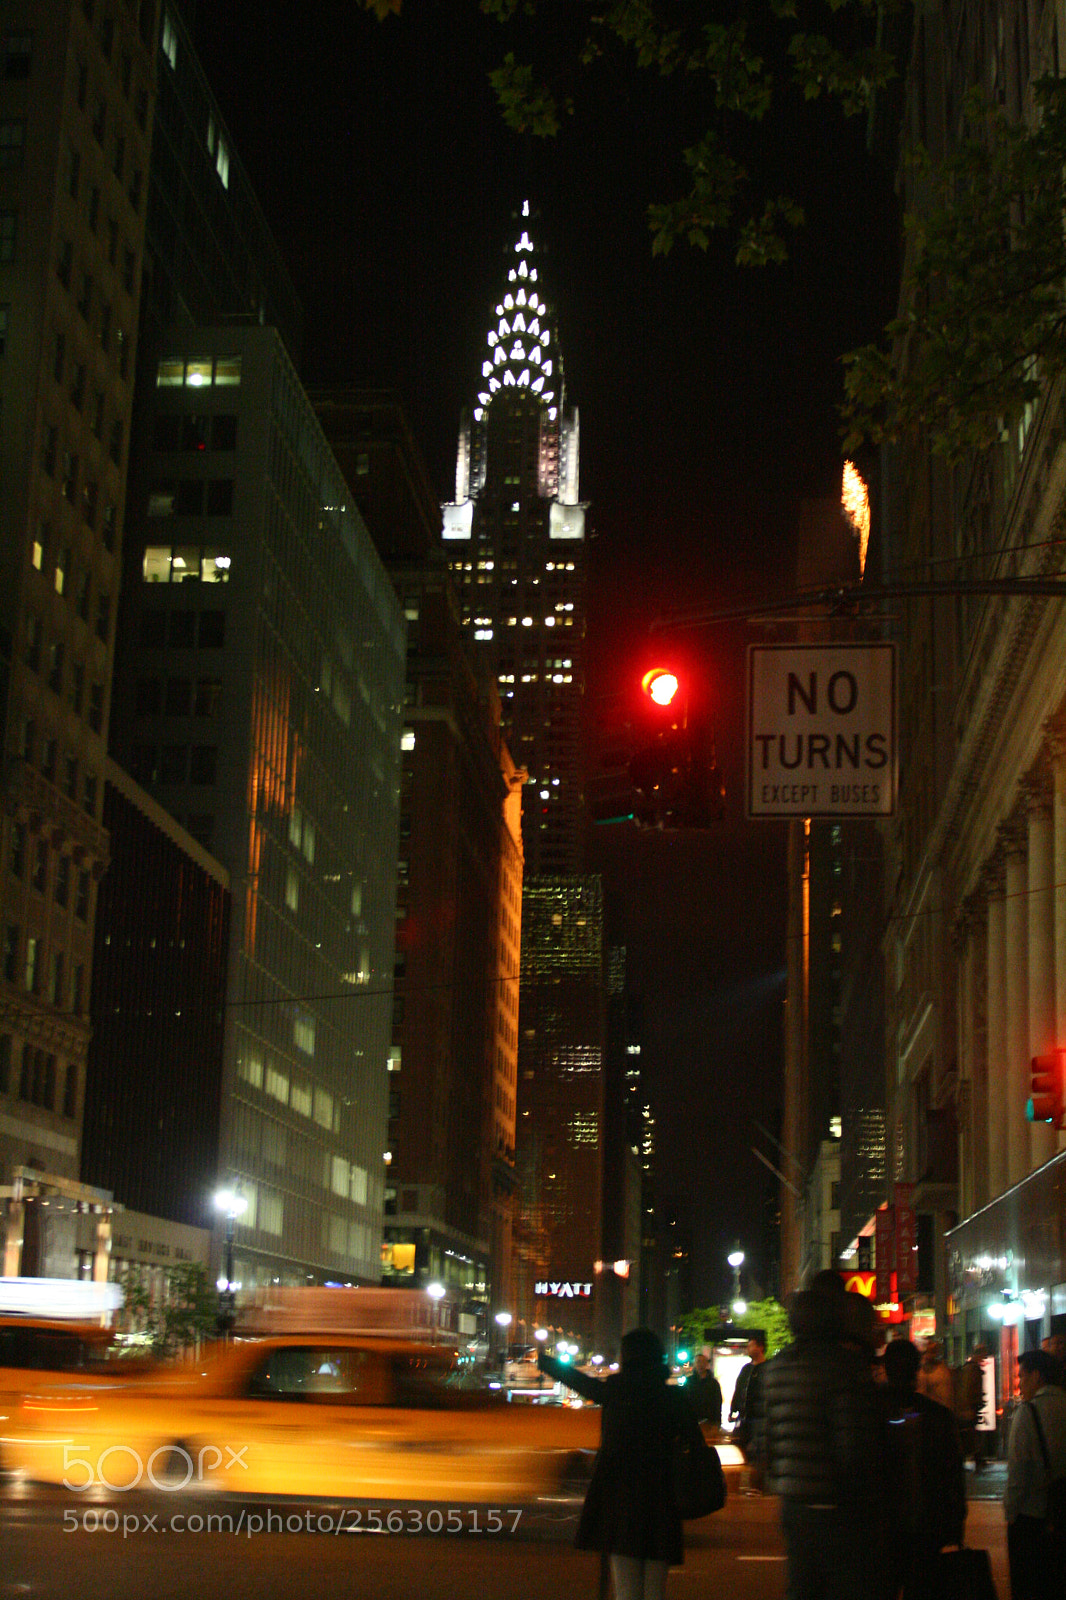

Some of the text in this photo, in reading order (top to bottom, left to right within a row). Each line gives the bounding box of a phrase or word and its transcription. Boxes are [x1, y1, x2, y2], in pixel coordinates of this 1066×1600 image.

[787, 670, 859, 716] NO
[755, 733, 889, 770] TURNS
[762, 784, 881, 804] EXCEPT BUSES
[900, 1210, 911, 1283] PASTA
[534, 1281, 594, 1298] HYATT
